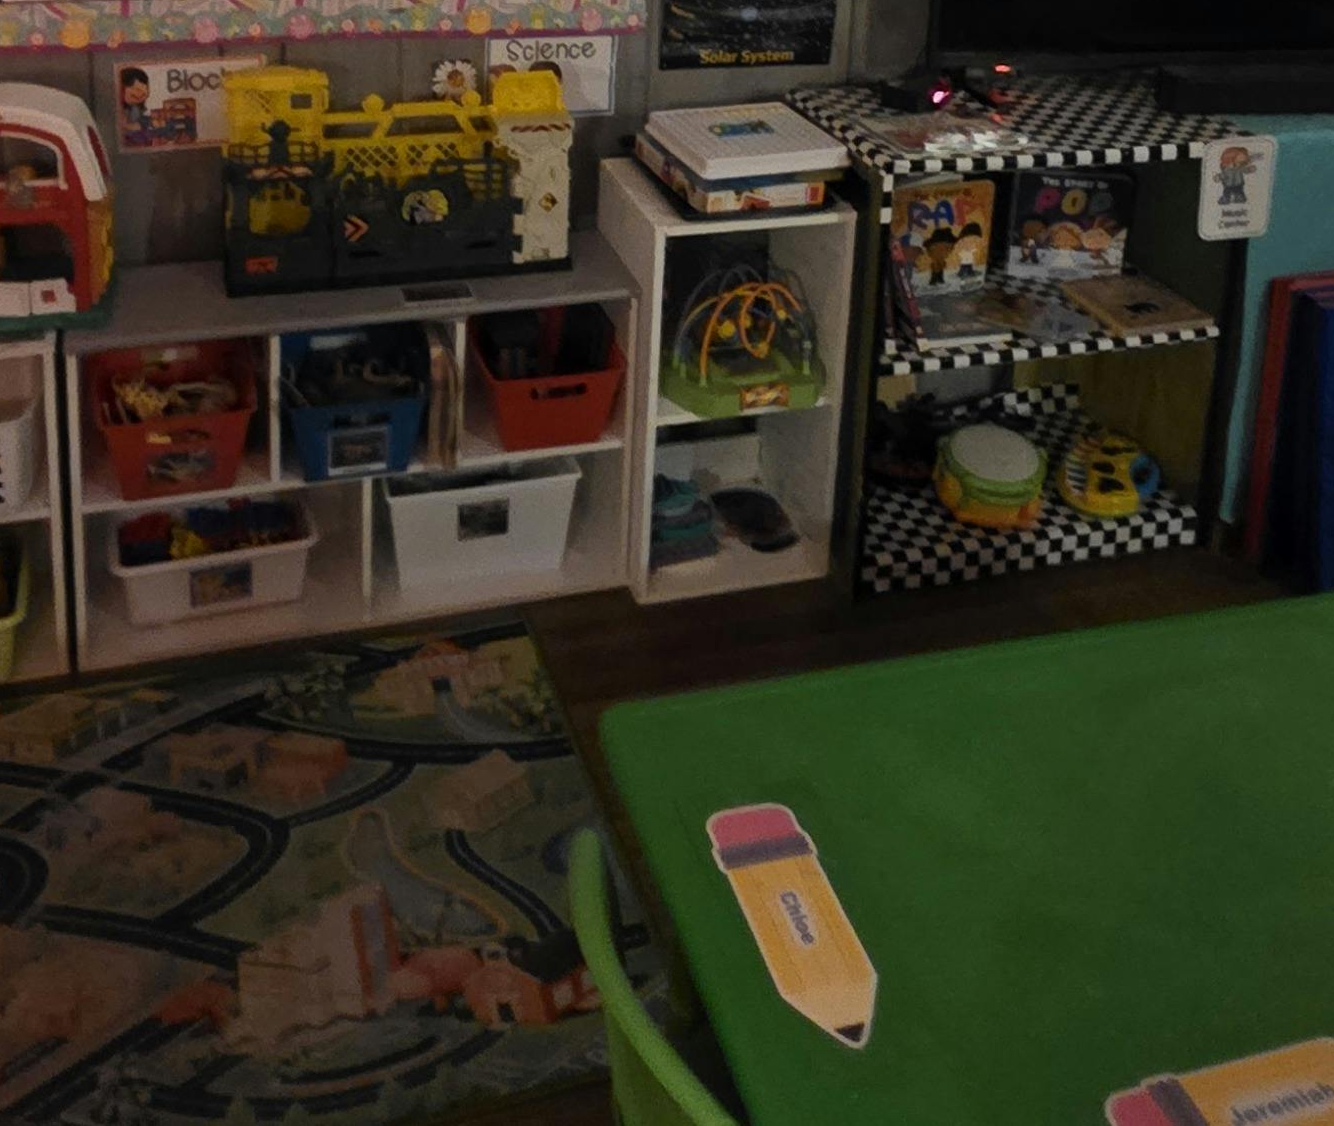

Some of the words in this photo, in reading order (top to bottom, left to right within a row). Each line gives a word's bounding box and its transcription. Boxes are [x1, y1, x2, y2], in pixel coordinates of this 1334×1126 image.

[505, 39, 597, 62] Science
[699, 48, 739, 65] Solar
[740, 50, 795, 65] System
[779, 890, 815, 946] Chloe
